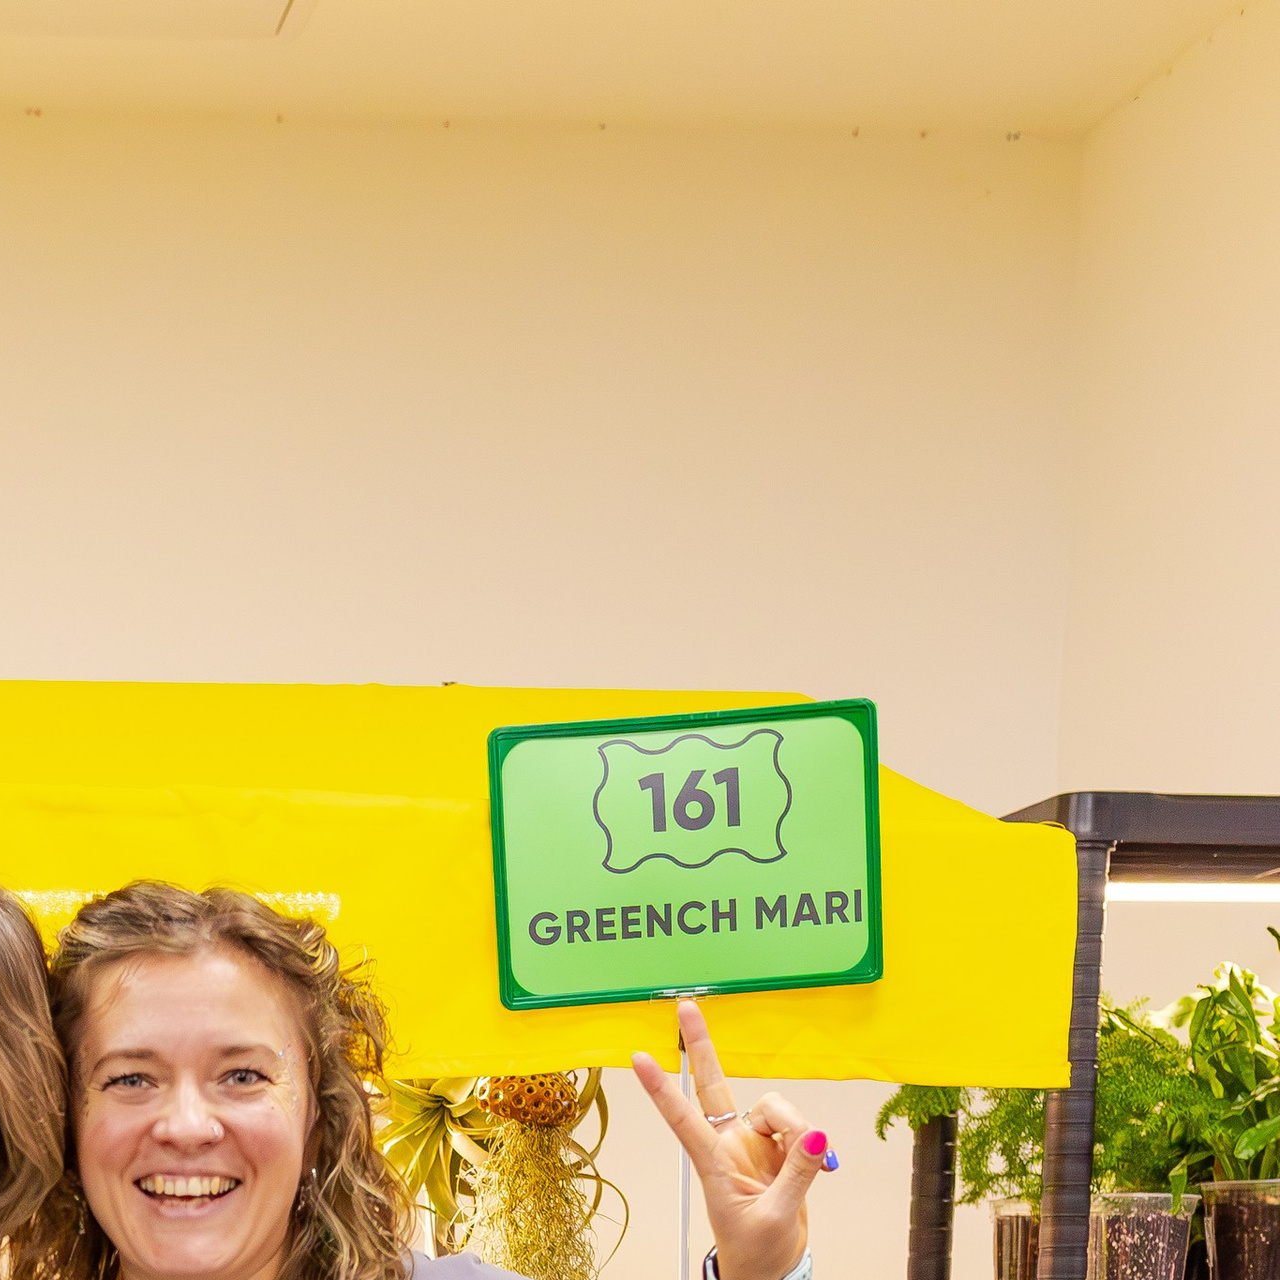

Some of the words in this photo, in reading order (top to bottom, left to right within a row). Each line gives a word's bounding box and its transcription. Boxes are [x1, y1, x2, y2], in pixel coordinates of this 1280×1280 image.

[638, 766, 741, 832] 161
[528, 898, 737, 946] GREENCH
[754, 888, 863, 930] MARI
